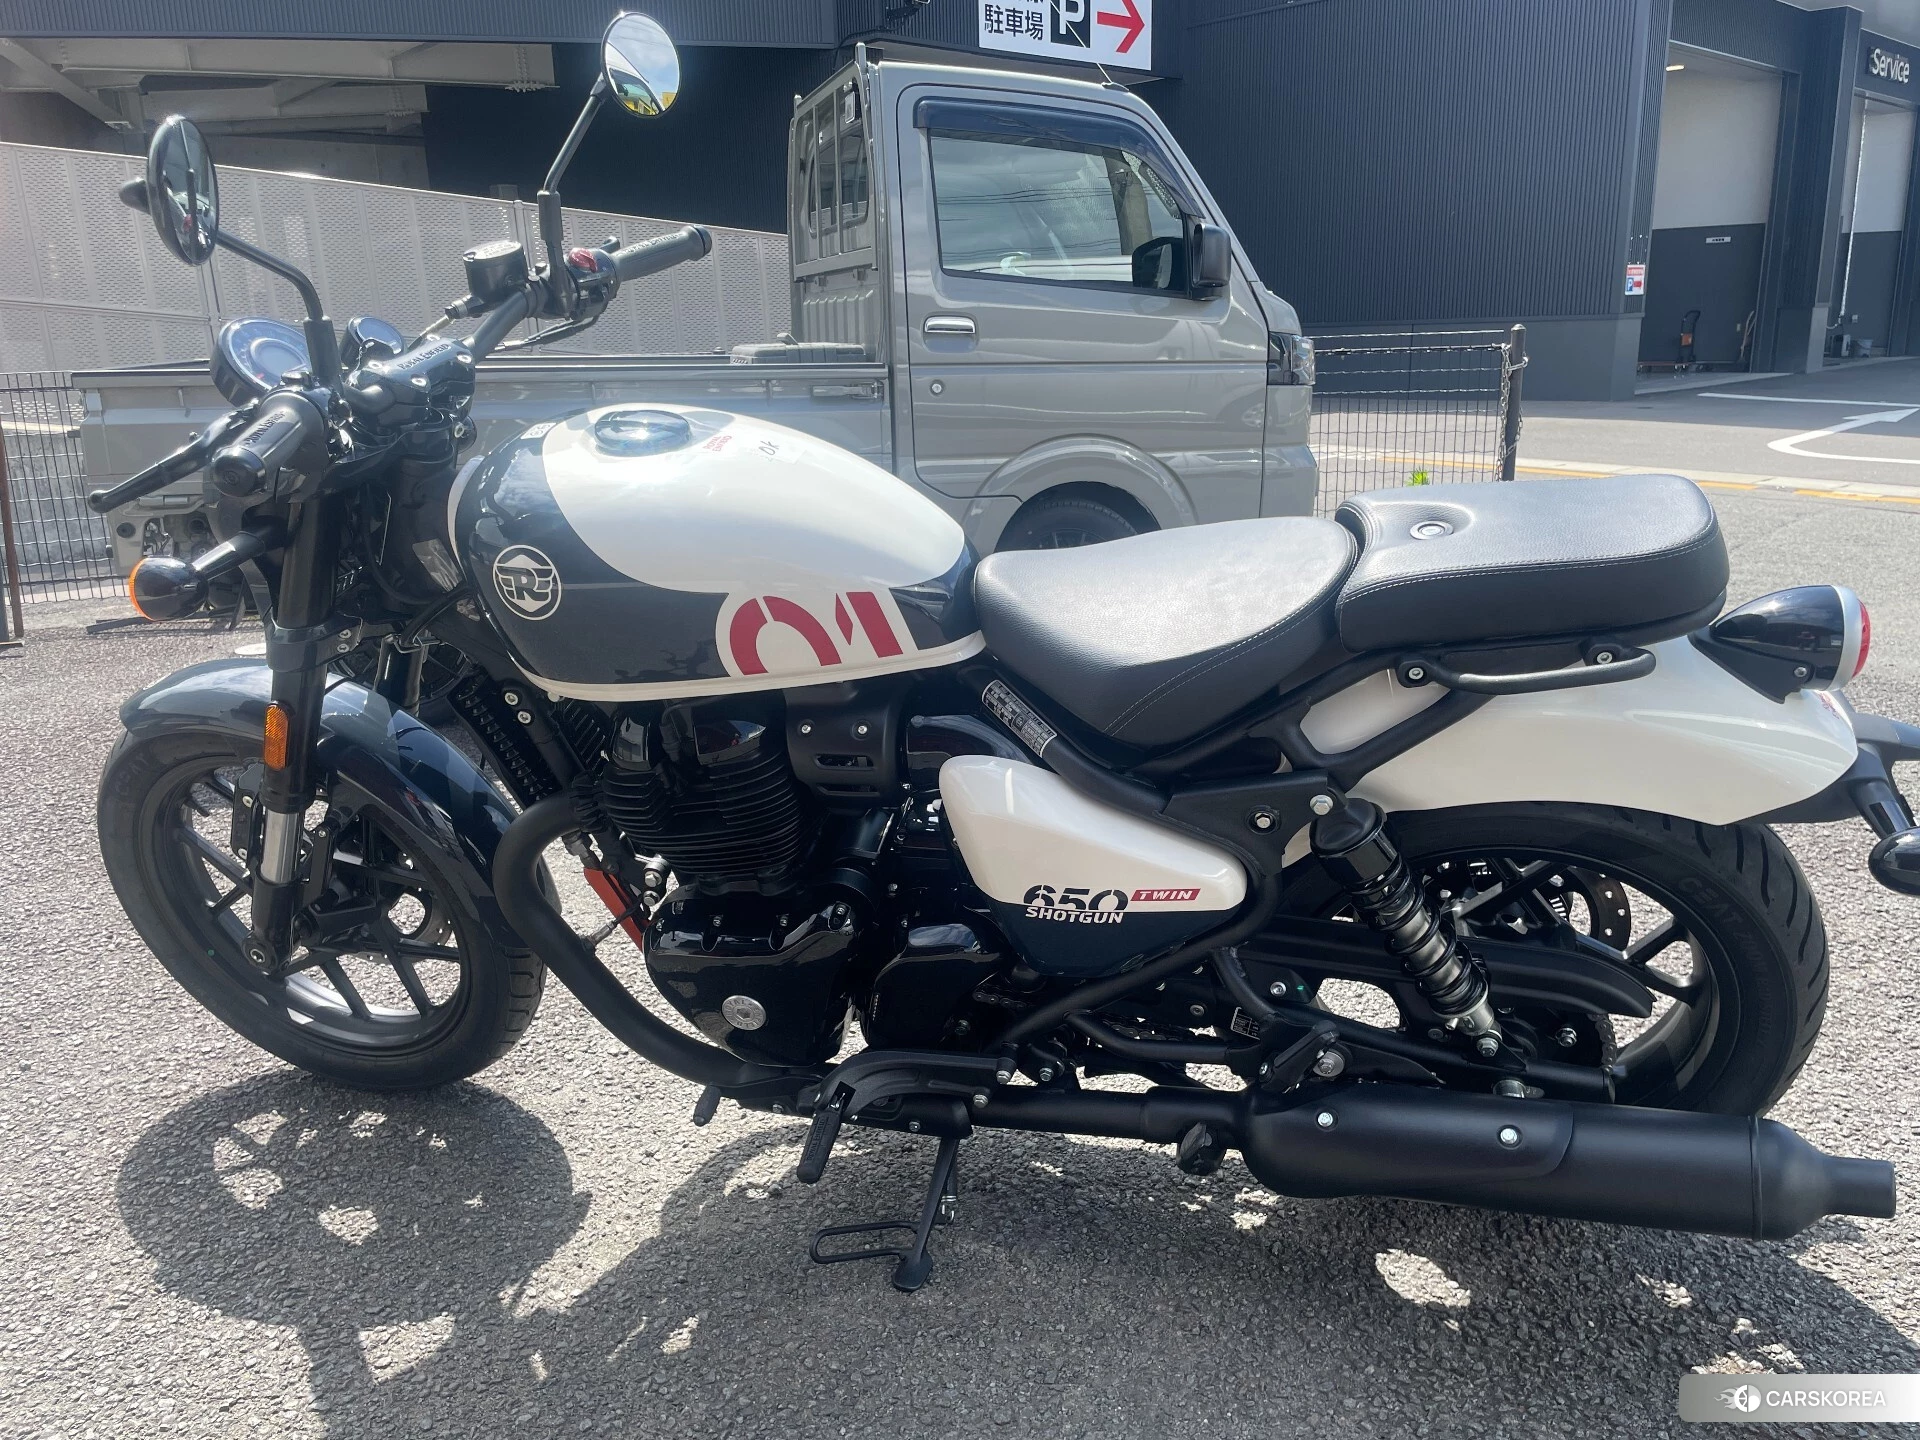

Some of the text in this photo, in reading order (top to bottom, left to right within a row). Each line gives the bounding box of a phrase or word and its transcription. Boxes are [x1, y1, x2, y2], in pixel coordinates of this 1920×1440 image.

[984, 3, 1044, 41] 駐車場
[1059, 0, 1085, 35] P
[1871, 48, 1910, 83] Service
[1023, 884, 1129, 912] 650
[1138, 889, 1193, 900] TWIN
[1025, 905, 1124, 924] SHOTGUN
